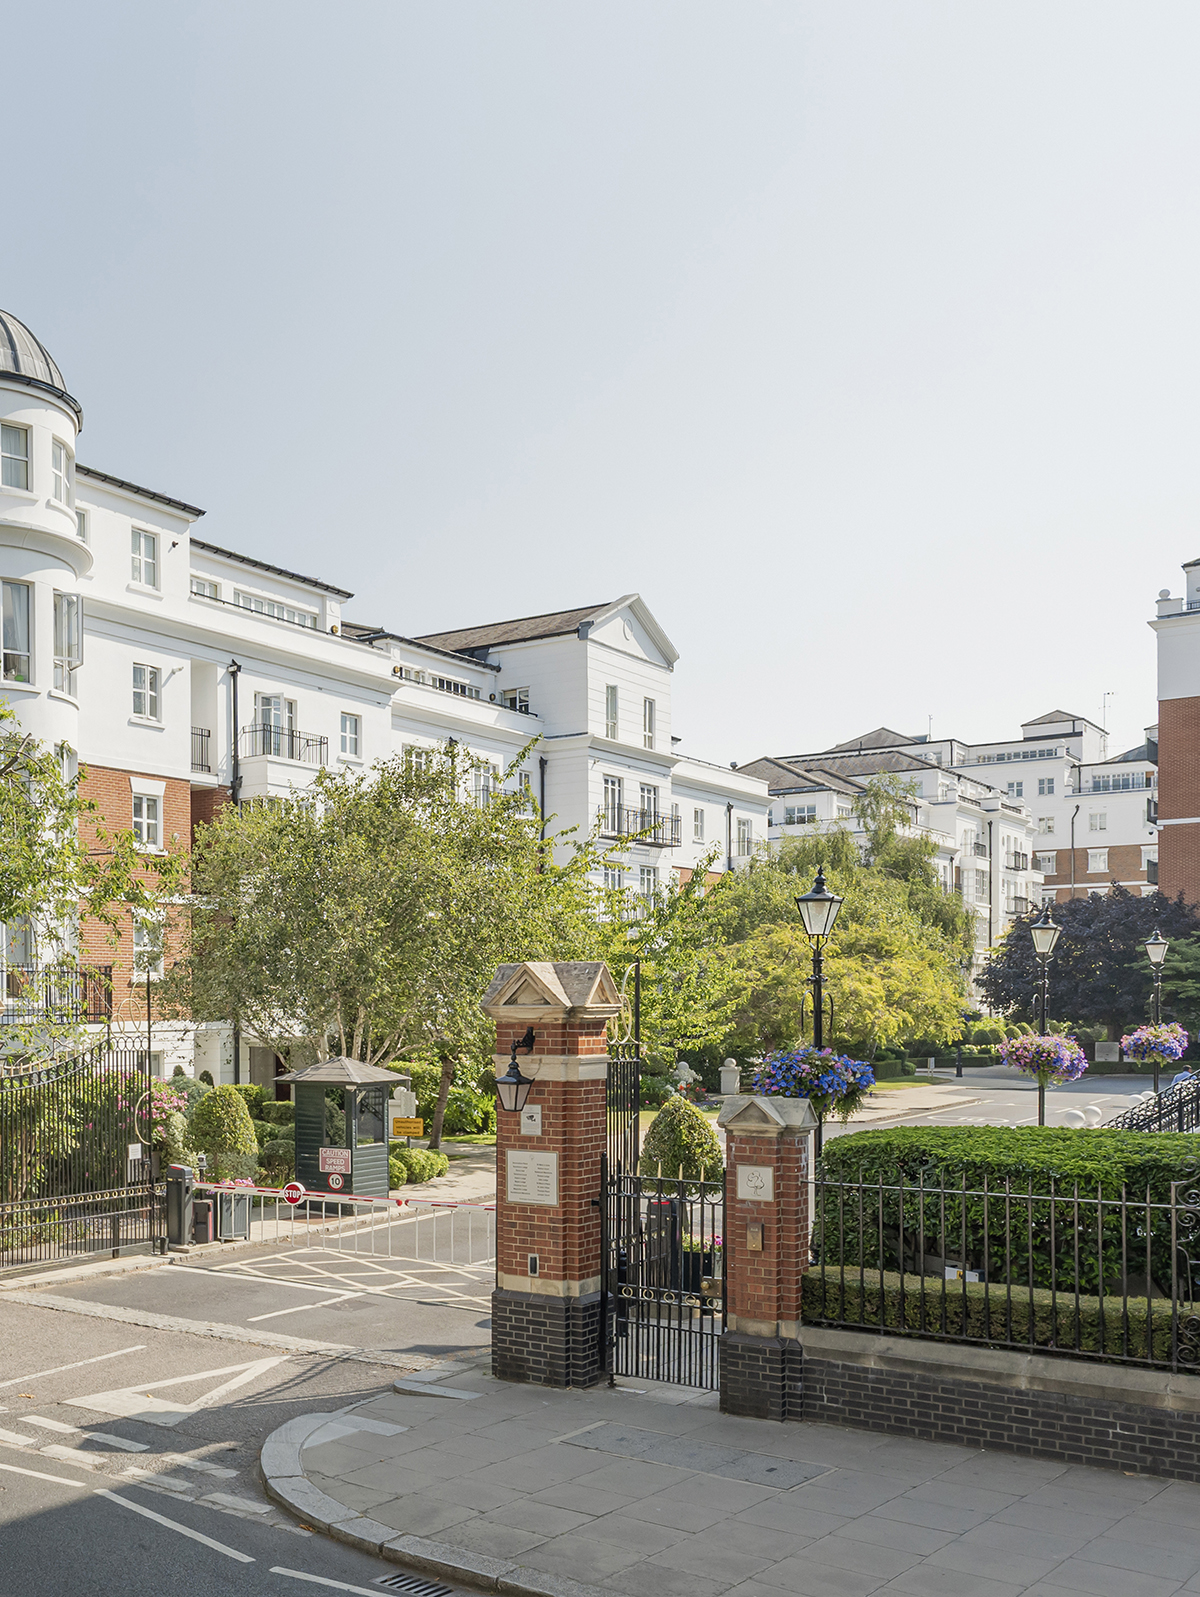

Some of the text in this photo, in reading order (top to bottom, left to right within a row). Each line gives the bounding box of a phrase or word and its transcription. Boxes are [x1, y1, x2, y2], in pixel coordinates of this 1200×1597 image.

[322, 1149, 348, 1157] CAUTION
[331, 1177, 341, 1185] 10
[284, 1190, 301, 1198] STOP
